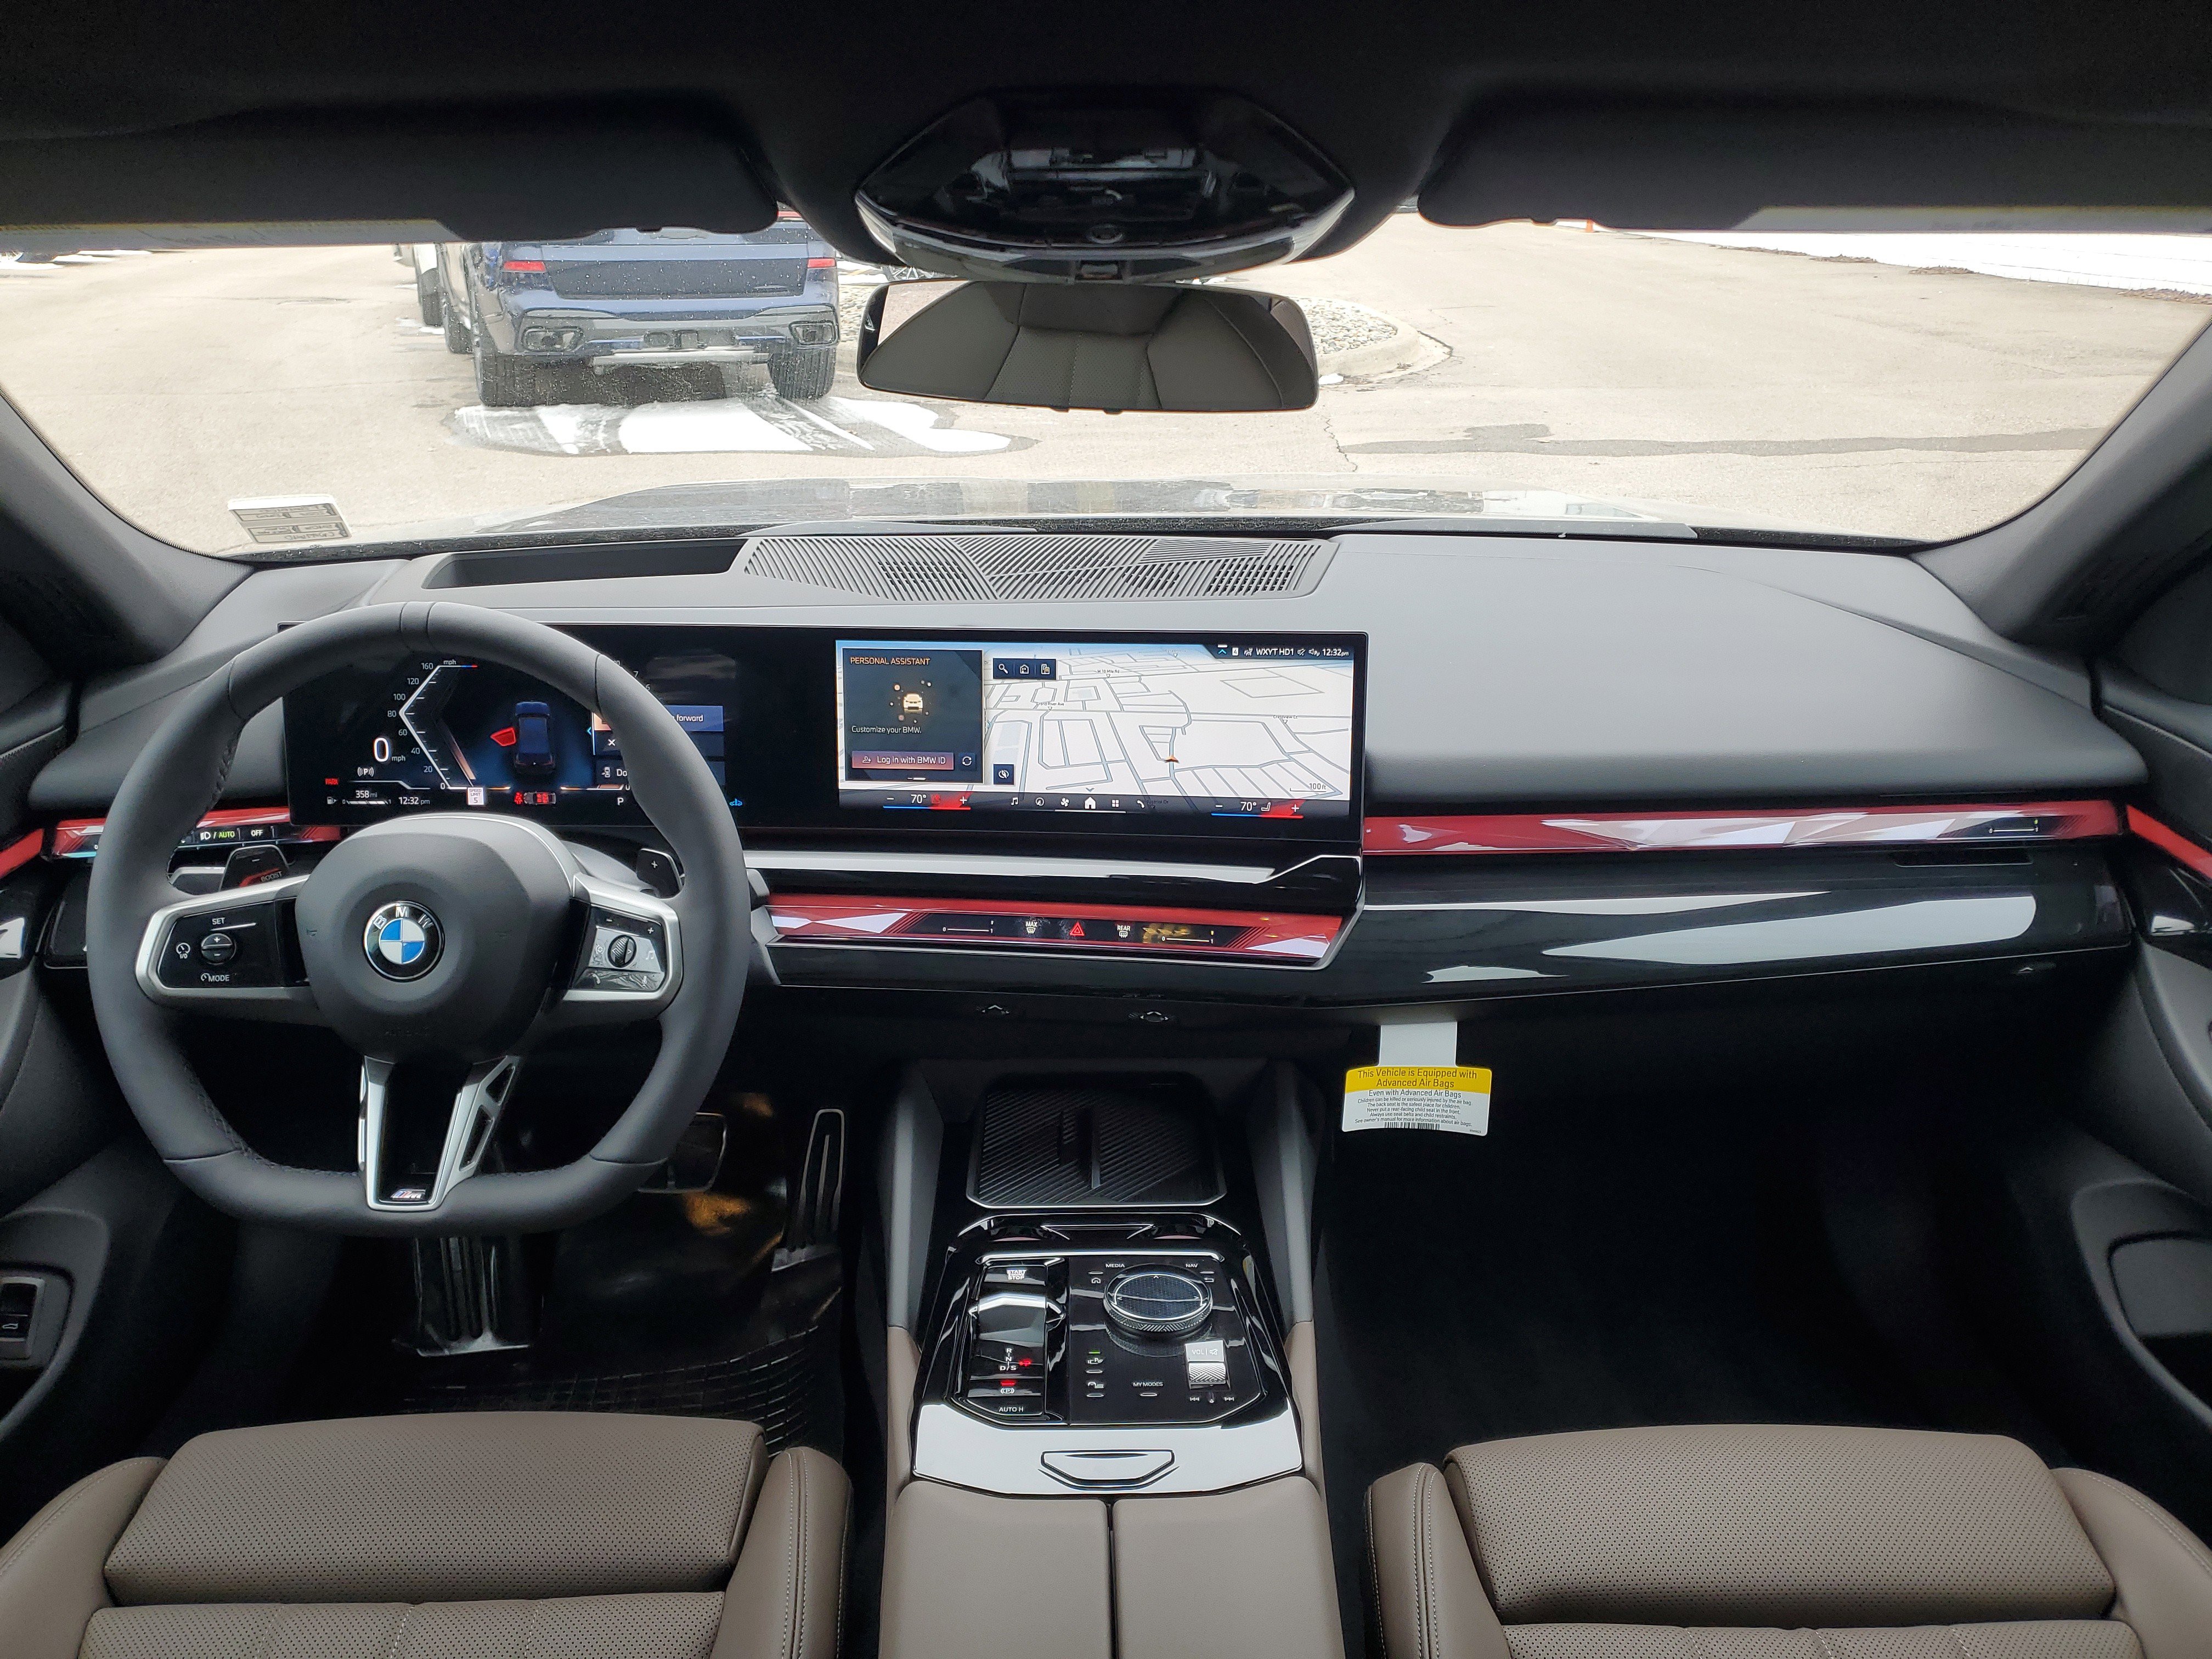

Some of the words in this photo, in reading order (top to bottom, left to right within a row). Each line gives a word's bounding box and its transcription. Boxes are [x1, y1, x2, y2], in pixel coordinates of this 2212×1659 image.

[1322, 648, 1349, 657] 12:32pm
[374, 737, 389, 762] 0
[877, 756, 890, 765] Log
[398, 797, 419, 805] 12:32
[261, 871, 282, 882] BOOST
[373, 906, 433, 929] BMW
[1358, 1070, 1374, 1079] This
[1376, 1068, 1406, 1076] Vehicle
[1417, 1068, 1457, 1079] Equipped
[1459, 1070, 1477, 1079] with
[1376, 1079, 1417, 1087] Advanced
[1419, 1078, 1431, 1087] Air
[1433, 1079, 1454, 1089] Bags
[1444, 1091, 1462, 1099] Bags
